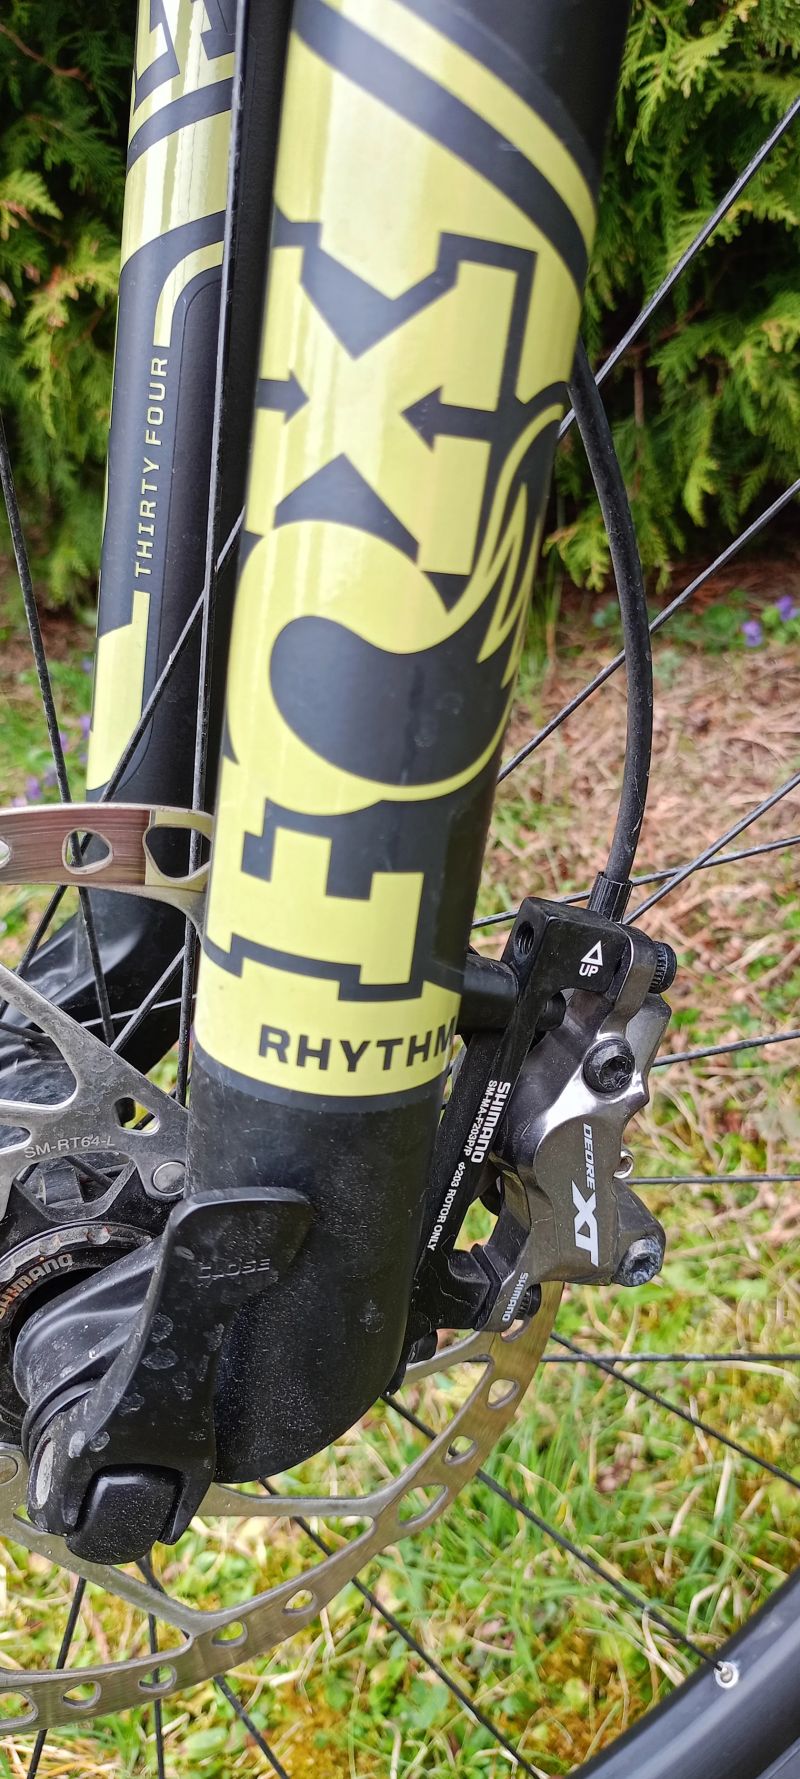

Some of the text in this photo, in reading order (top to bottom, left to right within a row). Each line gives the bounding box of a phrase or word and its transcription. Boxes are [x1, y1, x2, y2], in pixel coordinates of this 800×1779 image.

[135, 357, 168, 578] THIRTY FOUR
[579, 963, 599, 977] UP
[258, 1016, 456, 1073] RHYTHM
[464, 1080, 497, 1157] SM-MA-F203P/P
[471, 1082, 511, 1164] SHIMANO
[23, 1134, 116, 1159] SM-RT64-L
[436, 1188, 457, 1223] ROTOR
[571, 1123, 599, 1267] DEORE XT
[427, 1224, 443, 1251] ONLY
[502, 1272, 529, 1322] SHIMANO
